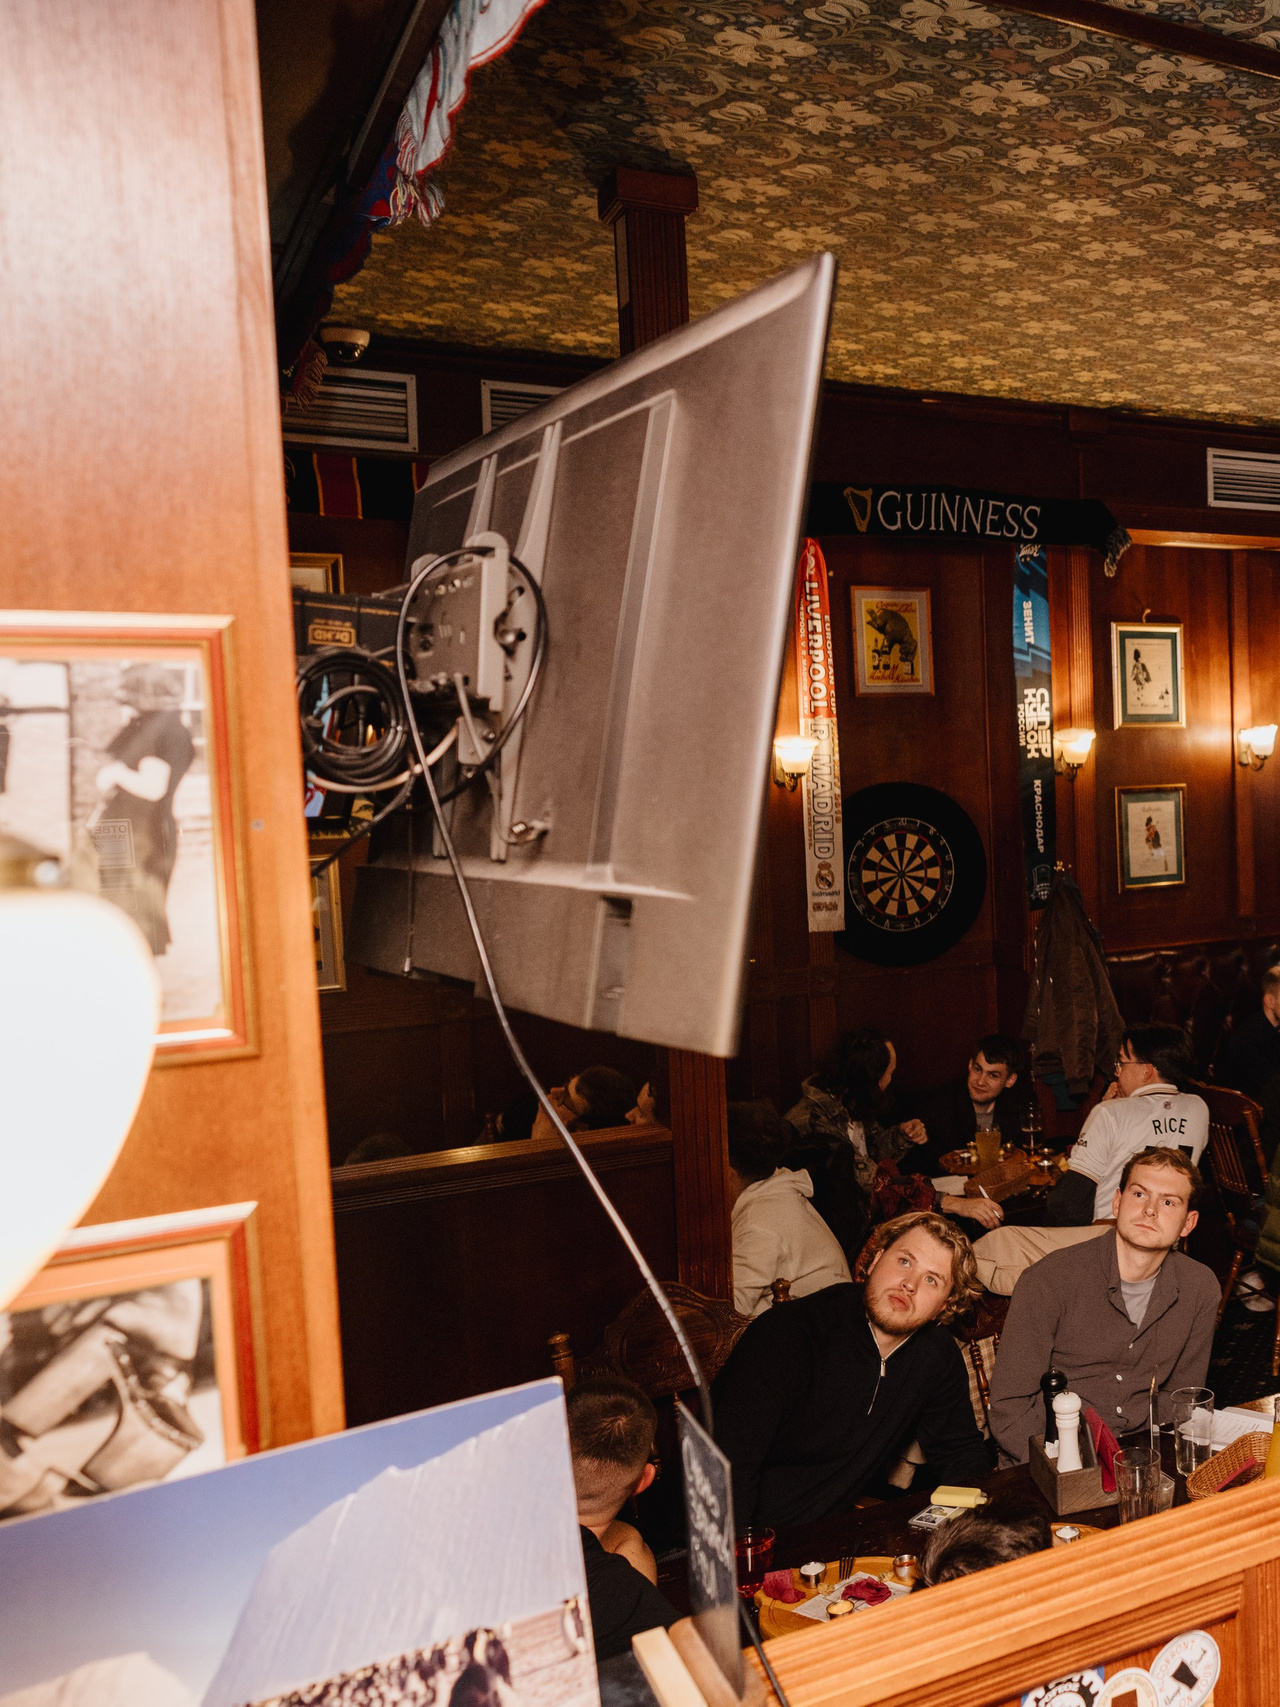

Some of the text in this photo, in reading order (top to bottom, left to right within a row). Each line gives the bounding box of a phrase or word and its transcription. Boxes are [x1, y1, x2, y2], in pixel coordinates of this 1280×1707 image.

[877, 490, 1041, 539] GUINNESS
[804, 581, 829, 714] LIVERPOOL
[1022, 600, 1035, 645] ЗЕНИТ
[824, 614, 837, 715] EUROPEAN CUP
[1017, 703, 1027, 747] РОССИИ
[1023, 687, 1040, 760] КУБОК
[1036, 687, 1052, 759] СУПЕР
[811, 754, 836, 861] MADRID
[1033, 779, 1045, 854] КРАСНОДАР
[1152, 1117, 1188, 1136] RICE
